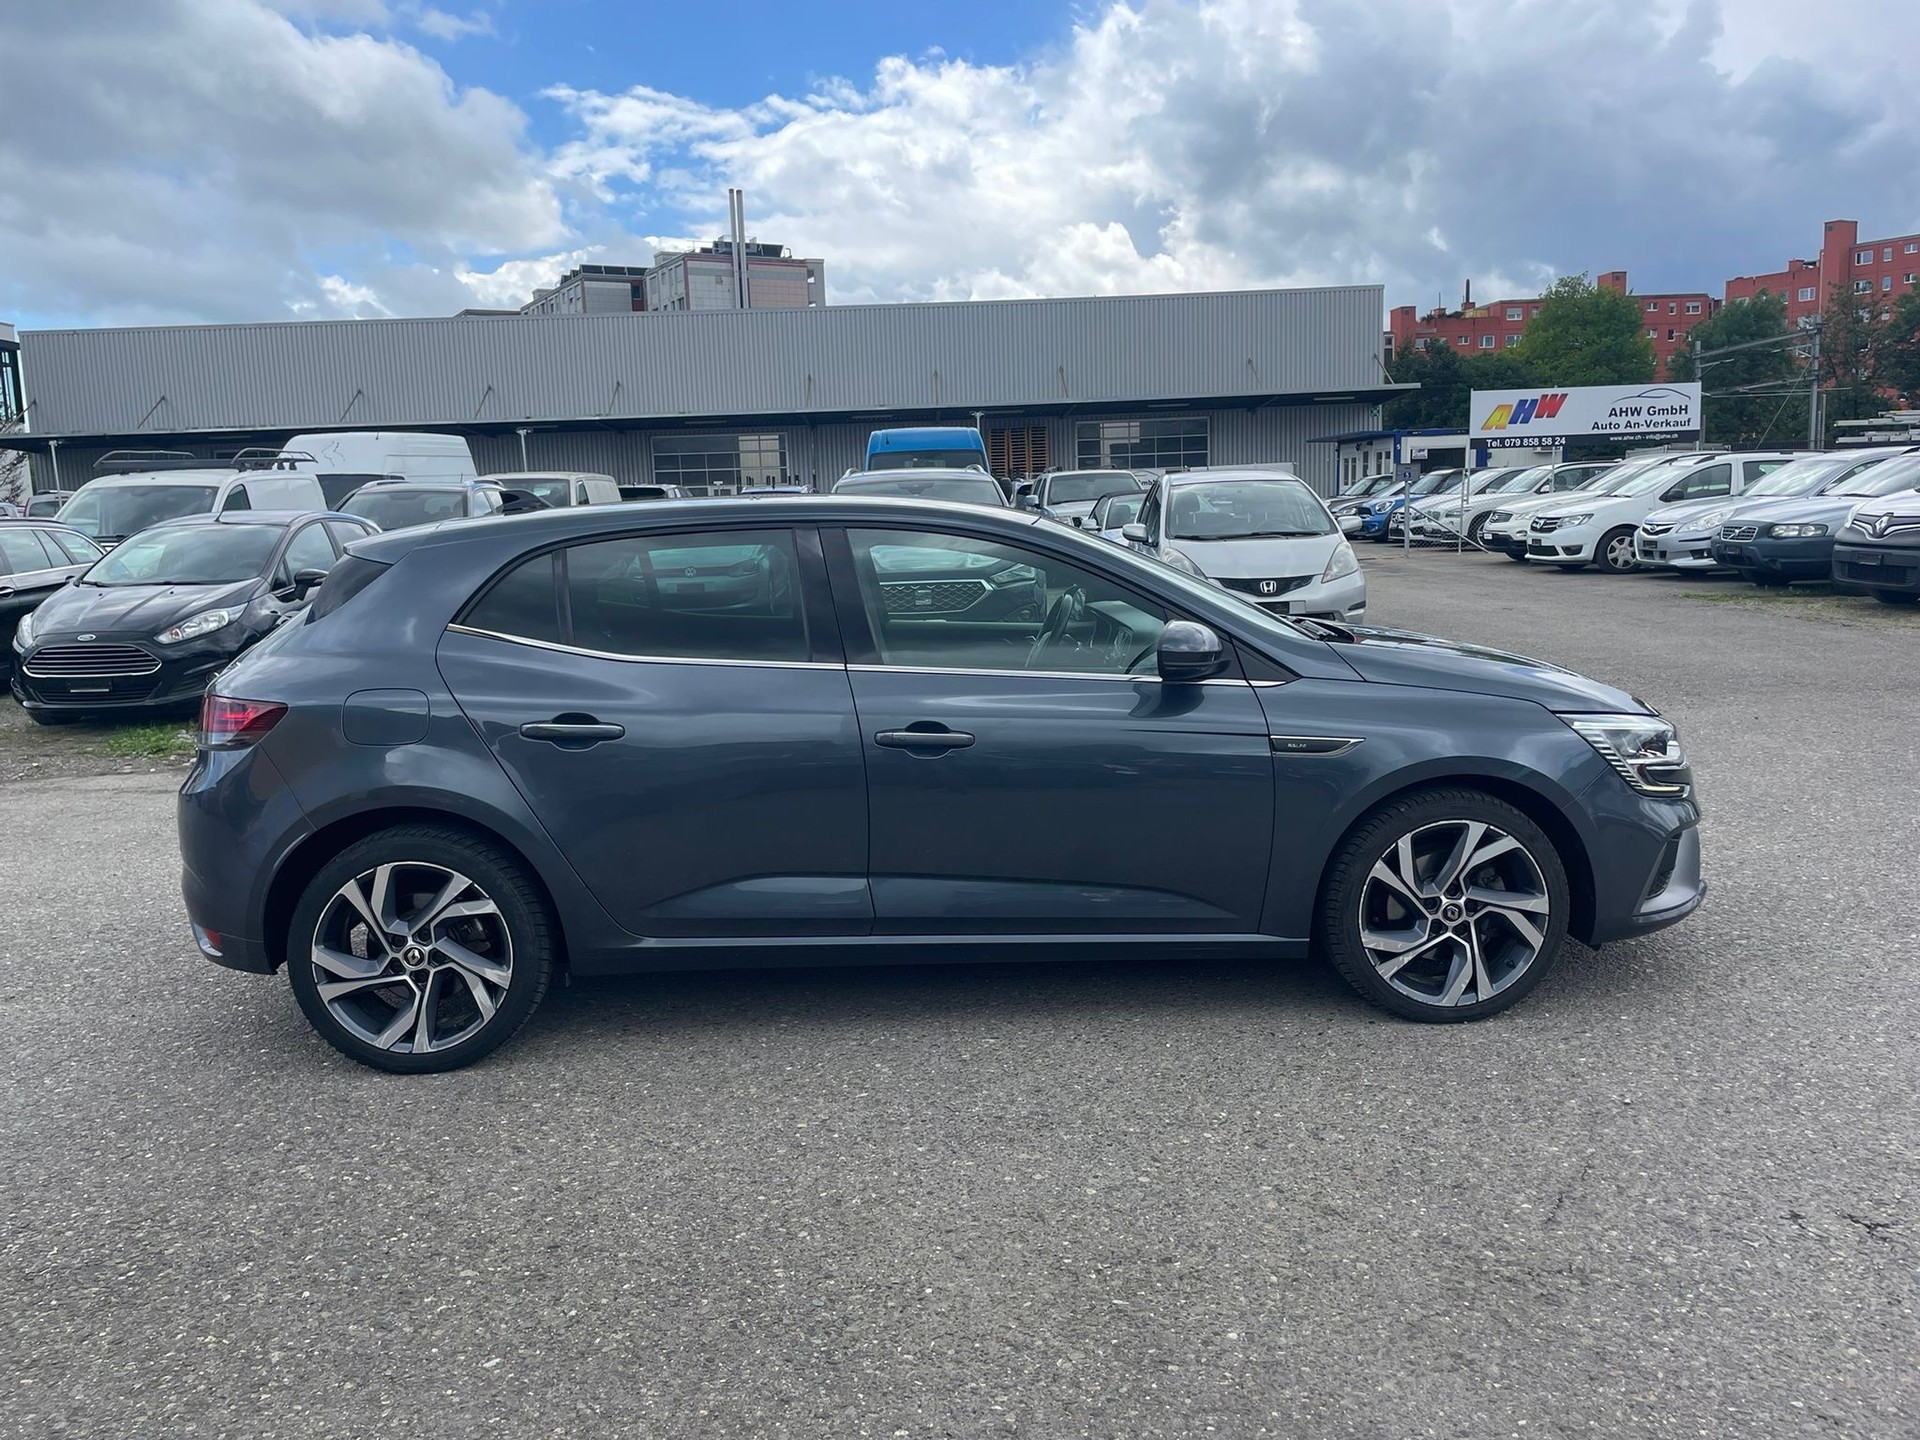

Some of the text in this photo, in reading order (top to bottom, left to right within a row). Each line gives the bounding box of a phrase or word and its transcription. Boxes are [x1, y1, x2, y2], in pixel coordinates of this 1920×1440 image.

[1481, 393, 1568, 430] AHW
[1608, 405, 1688, 417] AHW GmbH
[1591, 418, 1691, 430] Auto An-Verkauf
[1522, 438, 1539, 446] 858
[1554, 437, 1566, 445] 24
